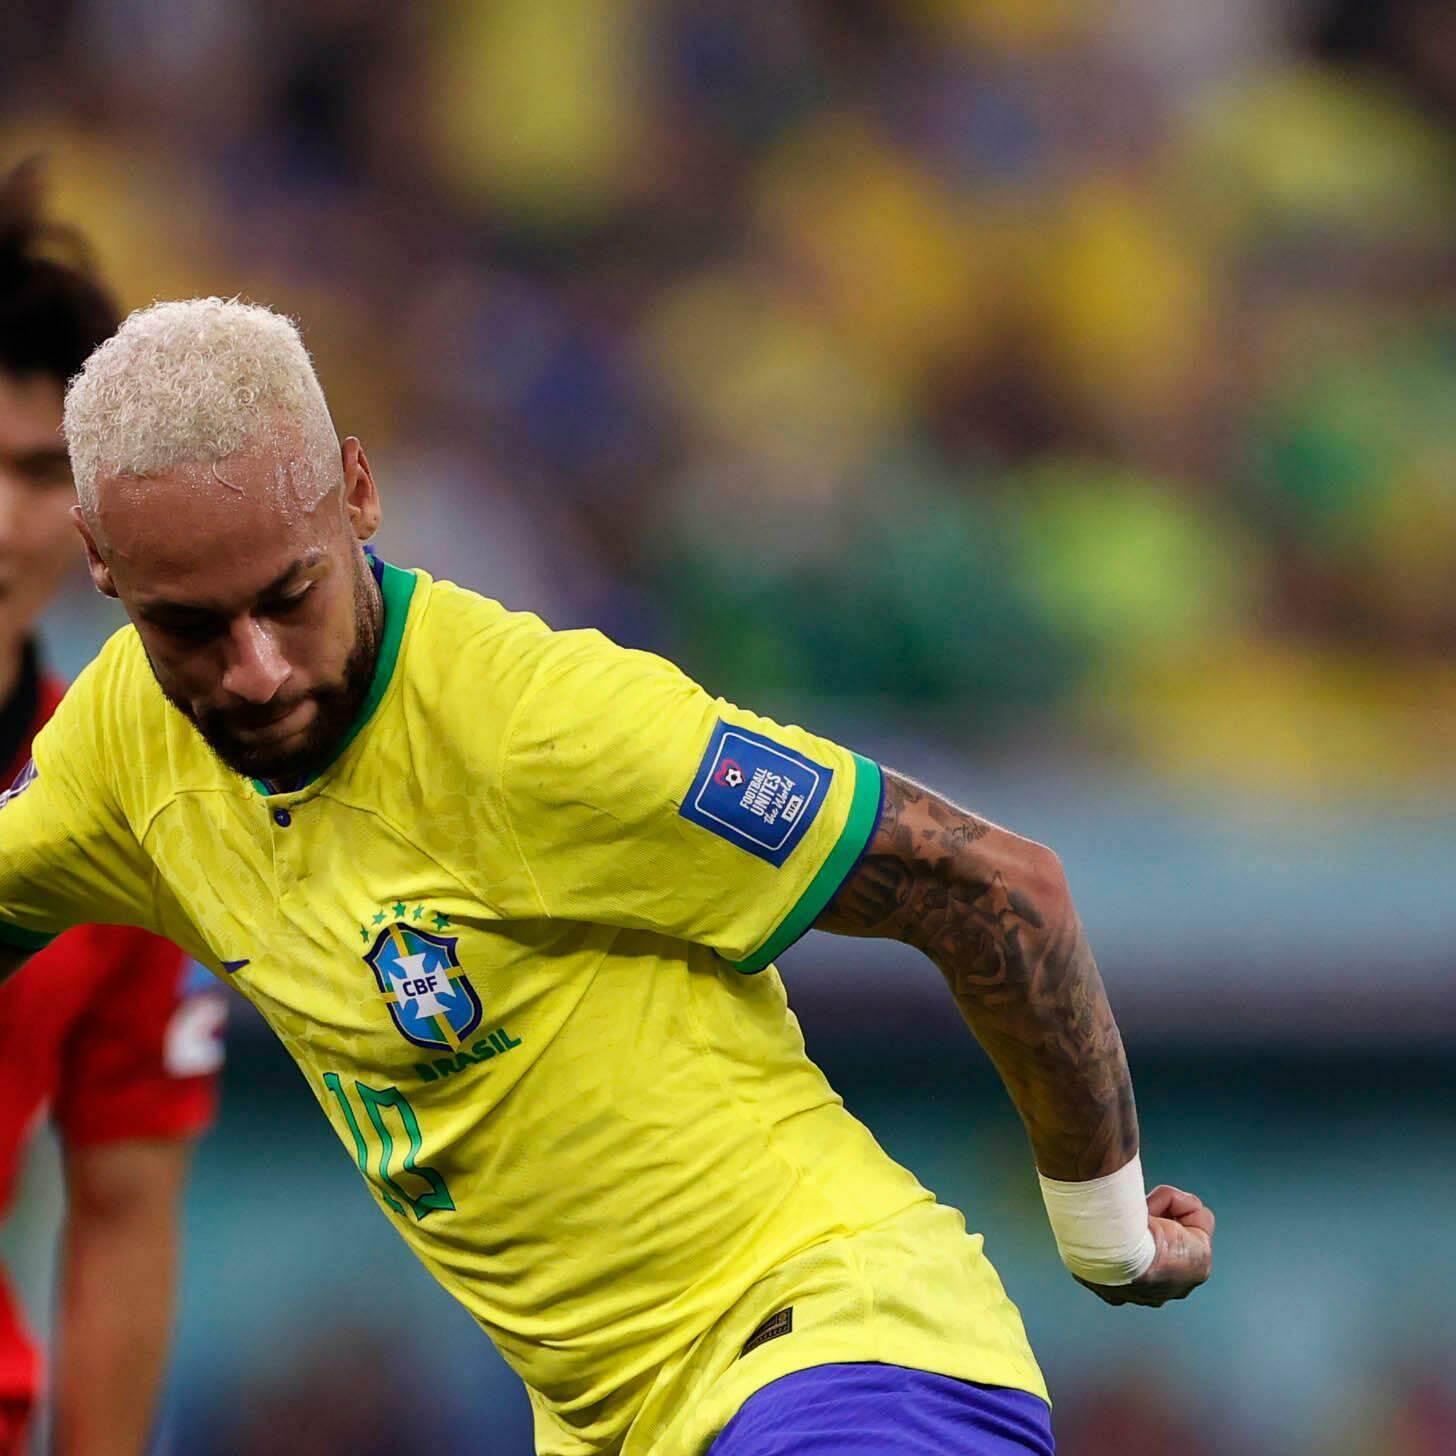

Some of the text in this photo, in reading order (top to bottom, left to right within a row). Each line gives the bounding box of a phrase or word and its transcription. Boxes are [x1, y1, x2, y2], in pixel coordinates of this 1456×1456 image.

[739, 768, 767, 810] FOOTBALL
[749, 771, 782, 817] UNITES
[763, 776, 796, 825] the World
[785, 800, 800, 818] FIFA
[401, 975, 438, 997] CBF
[413, 1026, 522, 1083] BRASIL
[323, 1071, 457, 1222] 10
